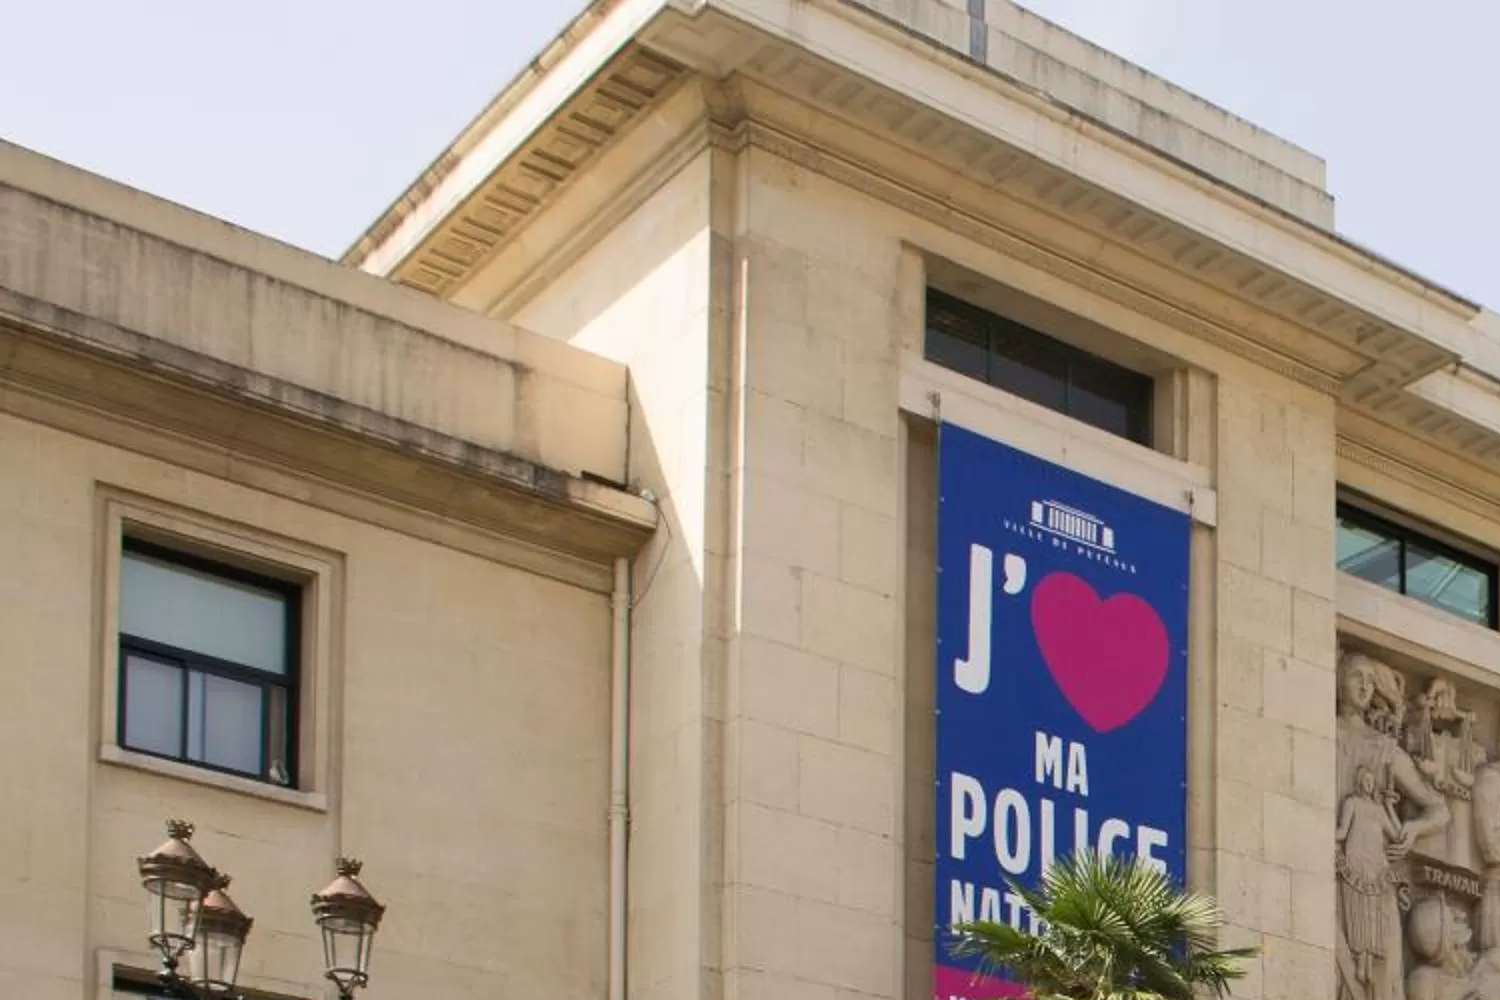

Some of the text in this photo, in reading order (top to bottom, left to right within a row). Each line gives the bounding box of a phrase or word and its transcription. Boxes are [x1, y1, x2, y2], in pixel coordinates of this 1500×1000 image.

[1035, 730, 1089, 796] MA
[951, 772, 1169, 878] POLICE
[1423, 864, 1484, 898] TRAVAIL
